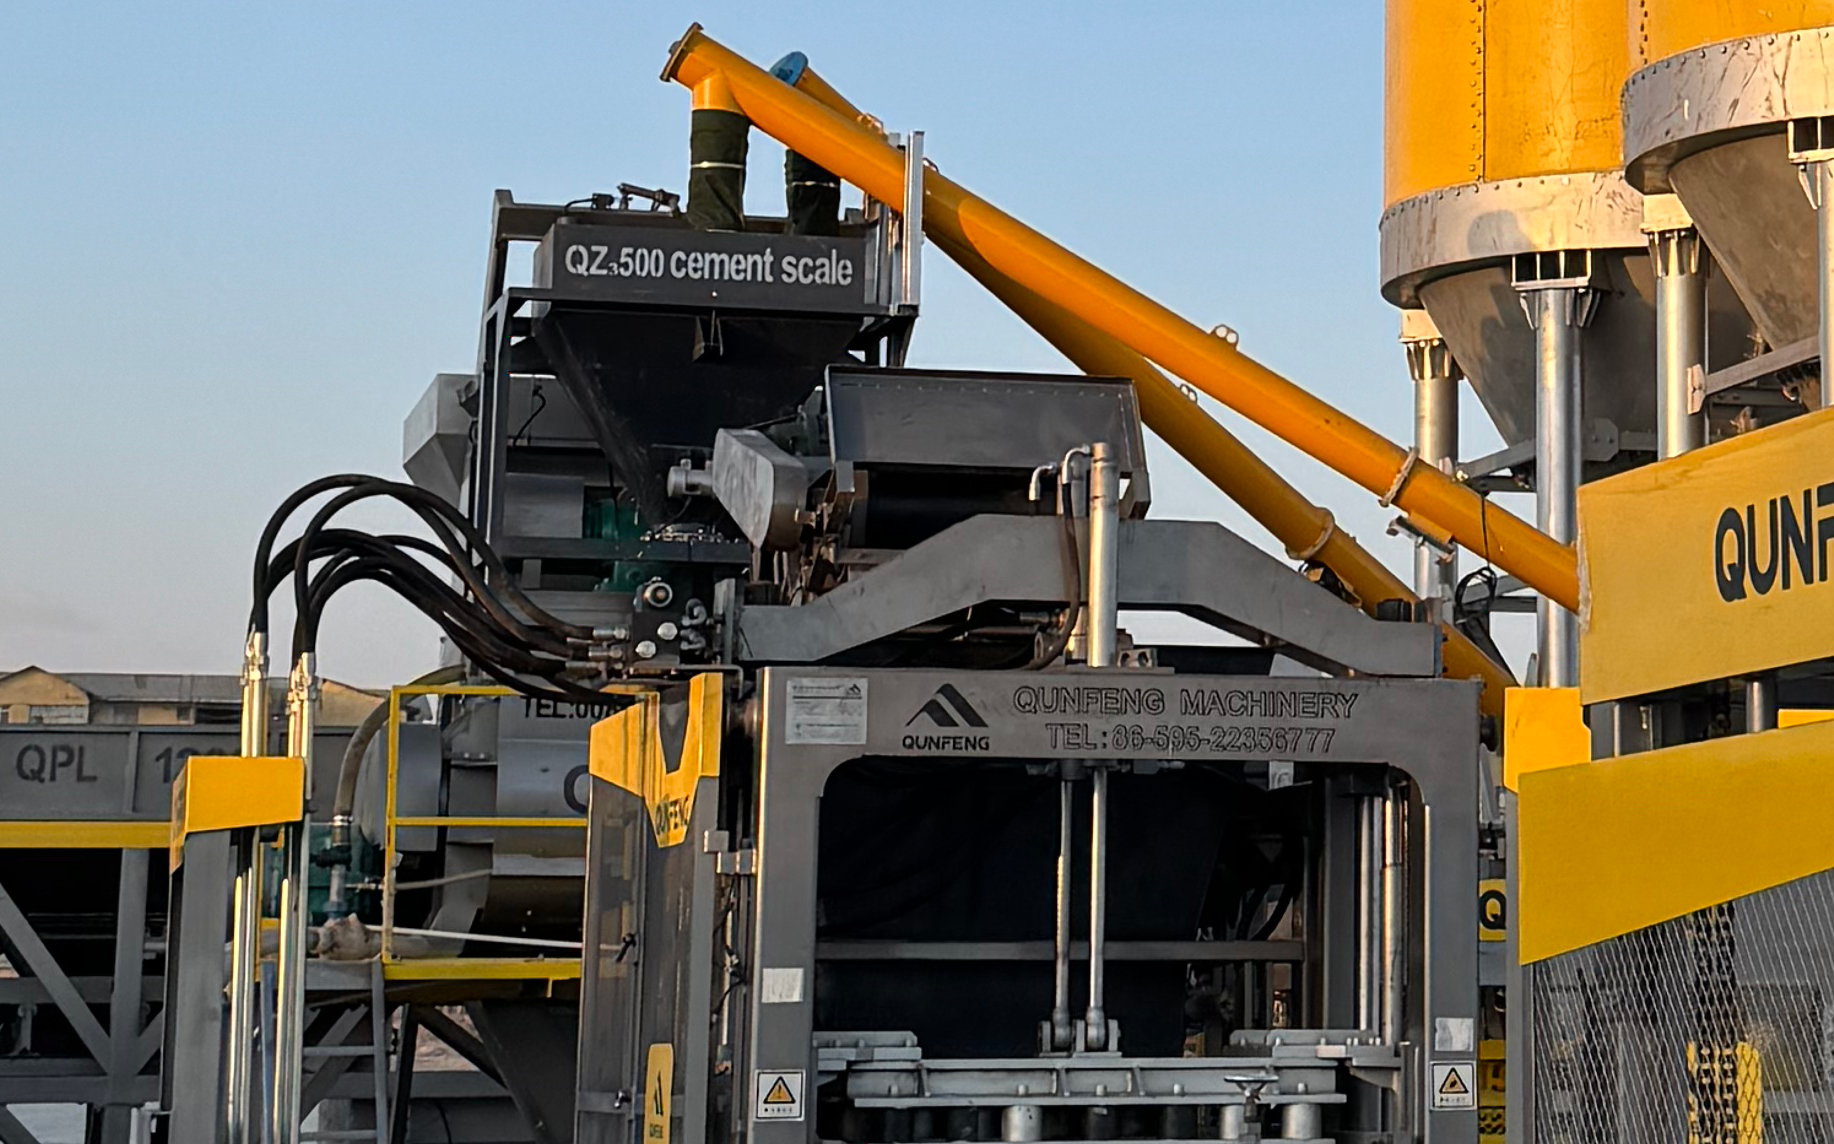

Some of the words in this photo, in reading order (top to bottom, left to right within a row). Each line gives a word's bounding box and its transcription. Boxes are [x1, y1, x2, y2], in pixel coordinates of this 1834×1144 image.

[669, 247, 774, 283] cement
[780, 249, 853, 286] scale
[1012, 686, 1166, 716] QUNFENG
[1179, 688, 1360, 719] MACHINERY
[901, 735, 990, 751] QUNFENG
[15, 744, 98, 784] QPL
